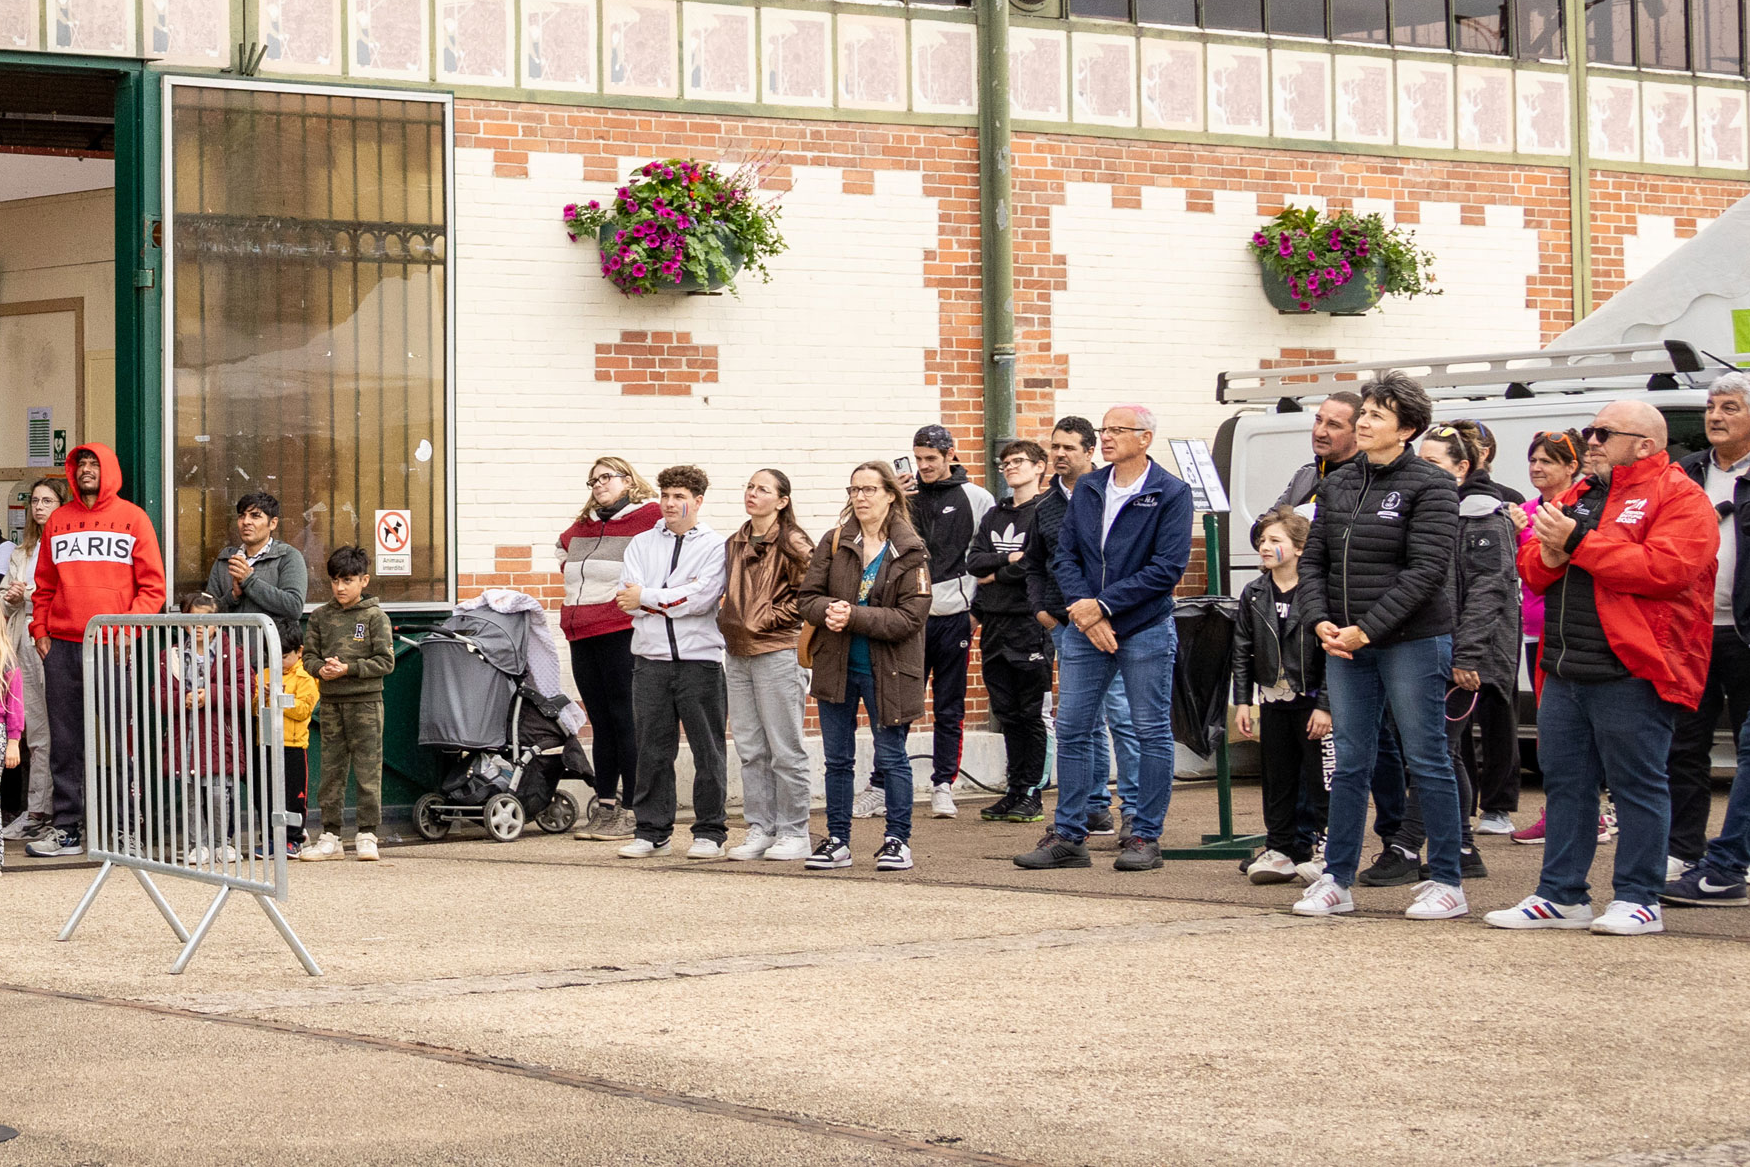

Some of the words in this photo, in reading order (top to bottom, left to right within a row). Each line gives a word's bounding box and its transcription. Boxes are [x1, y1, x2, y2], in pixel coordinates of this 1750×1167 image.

[55, 537, 130, 560] PARIS
[354, 623, 365, 639] R
[1321, 727, 1337, 792] APPINESS
